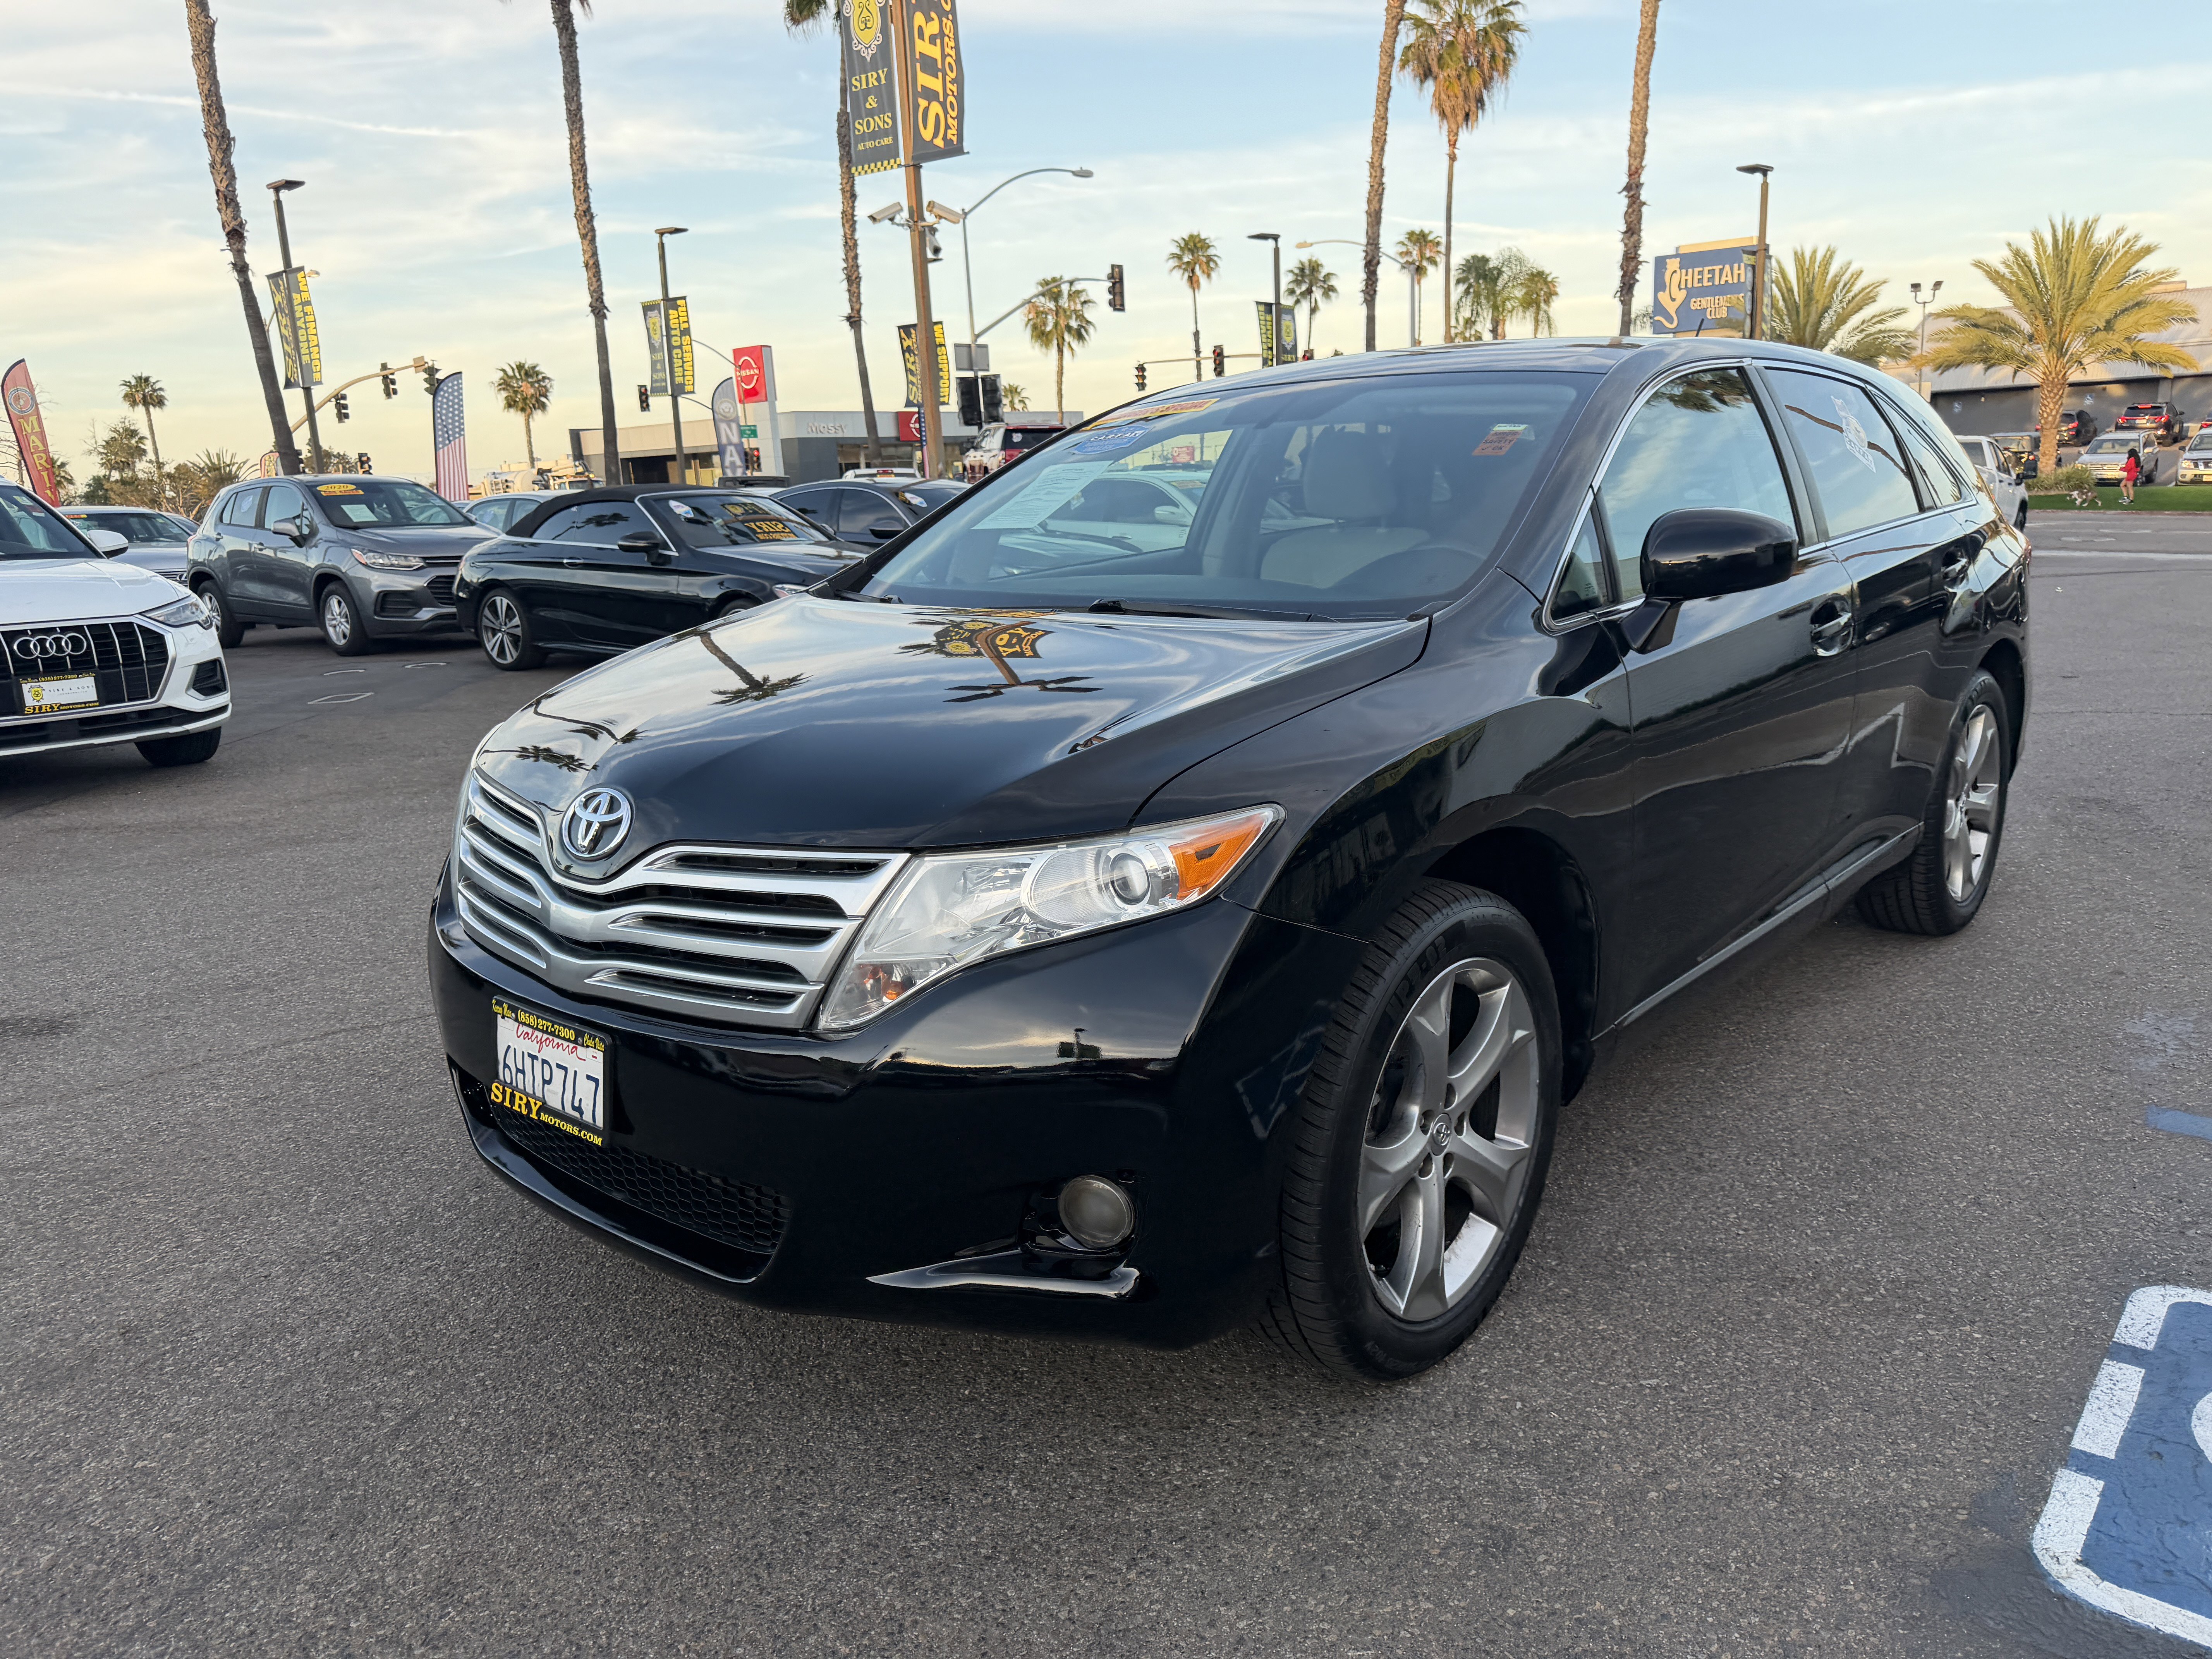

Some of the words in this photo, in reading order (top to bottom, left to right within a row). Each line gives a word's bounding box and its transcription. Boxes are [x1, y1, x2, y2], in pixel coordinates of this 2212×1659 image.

[852, 68, 888, 91] SIRY
[912, 0, 945, 149] SIR
[865, 95, 878, 109] &
[854, 113, 892, 135] SONS
[857, 140, 874, 151] AUTO
[876, 137, 893, 147] CARE
[292, 293, 310, 365] ANYONE
[297, 271, 310, 302] WE
[304, 305, 321, 382] FINANCE
[668, 309, 681, 346] AUTO
[677, 300, 689, 331] FULL
[1706, 306, 1727, 319] CLUB
[933, 324, 945, 345] WE
[673, 349, 684, 384] CARE
[681, 335, 694, 392] SERVICE
[900, 328, 918, 404] SIRY
[937, 346, 949, 403] SUPPORT
[516, 1024, 586, 1061] California
[503, 1044, 599, 1125] 6HTP747
